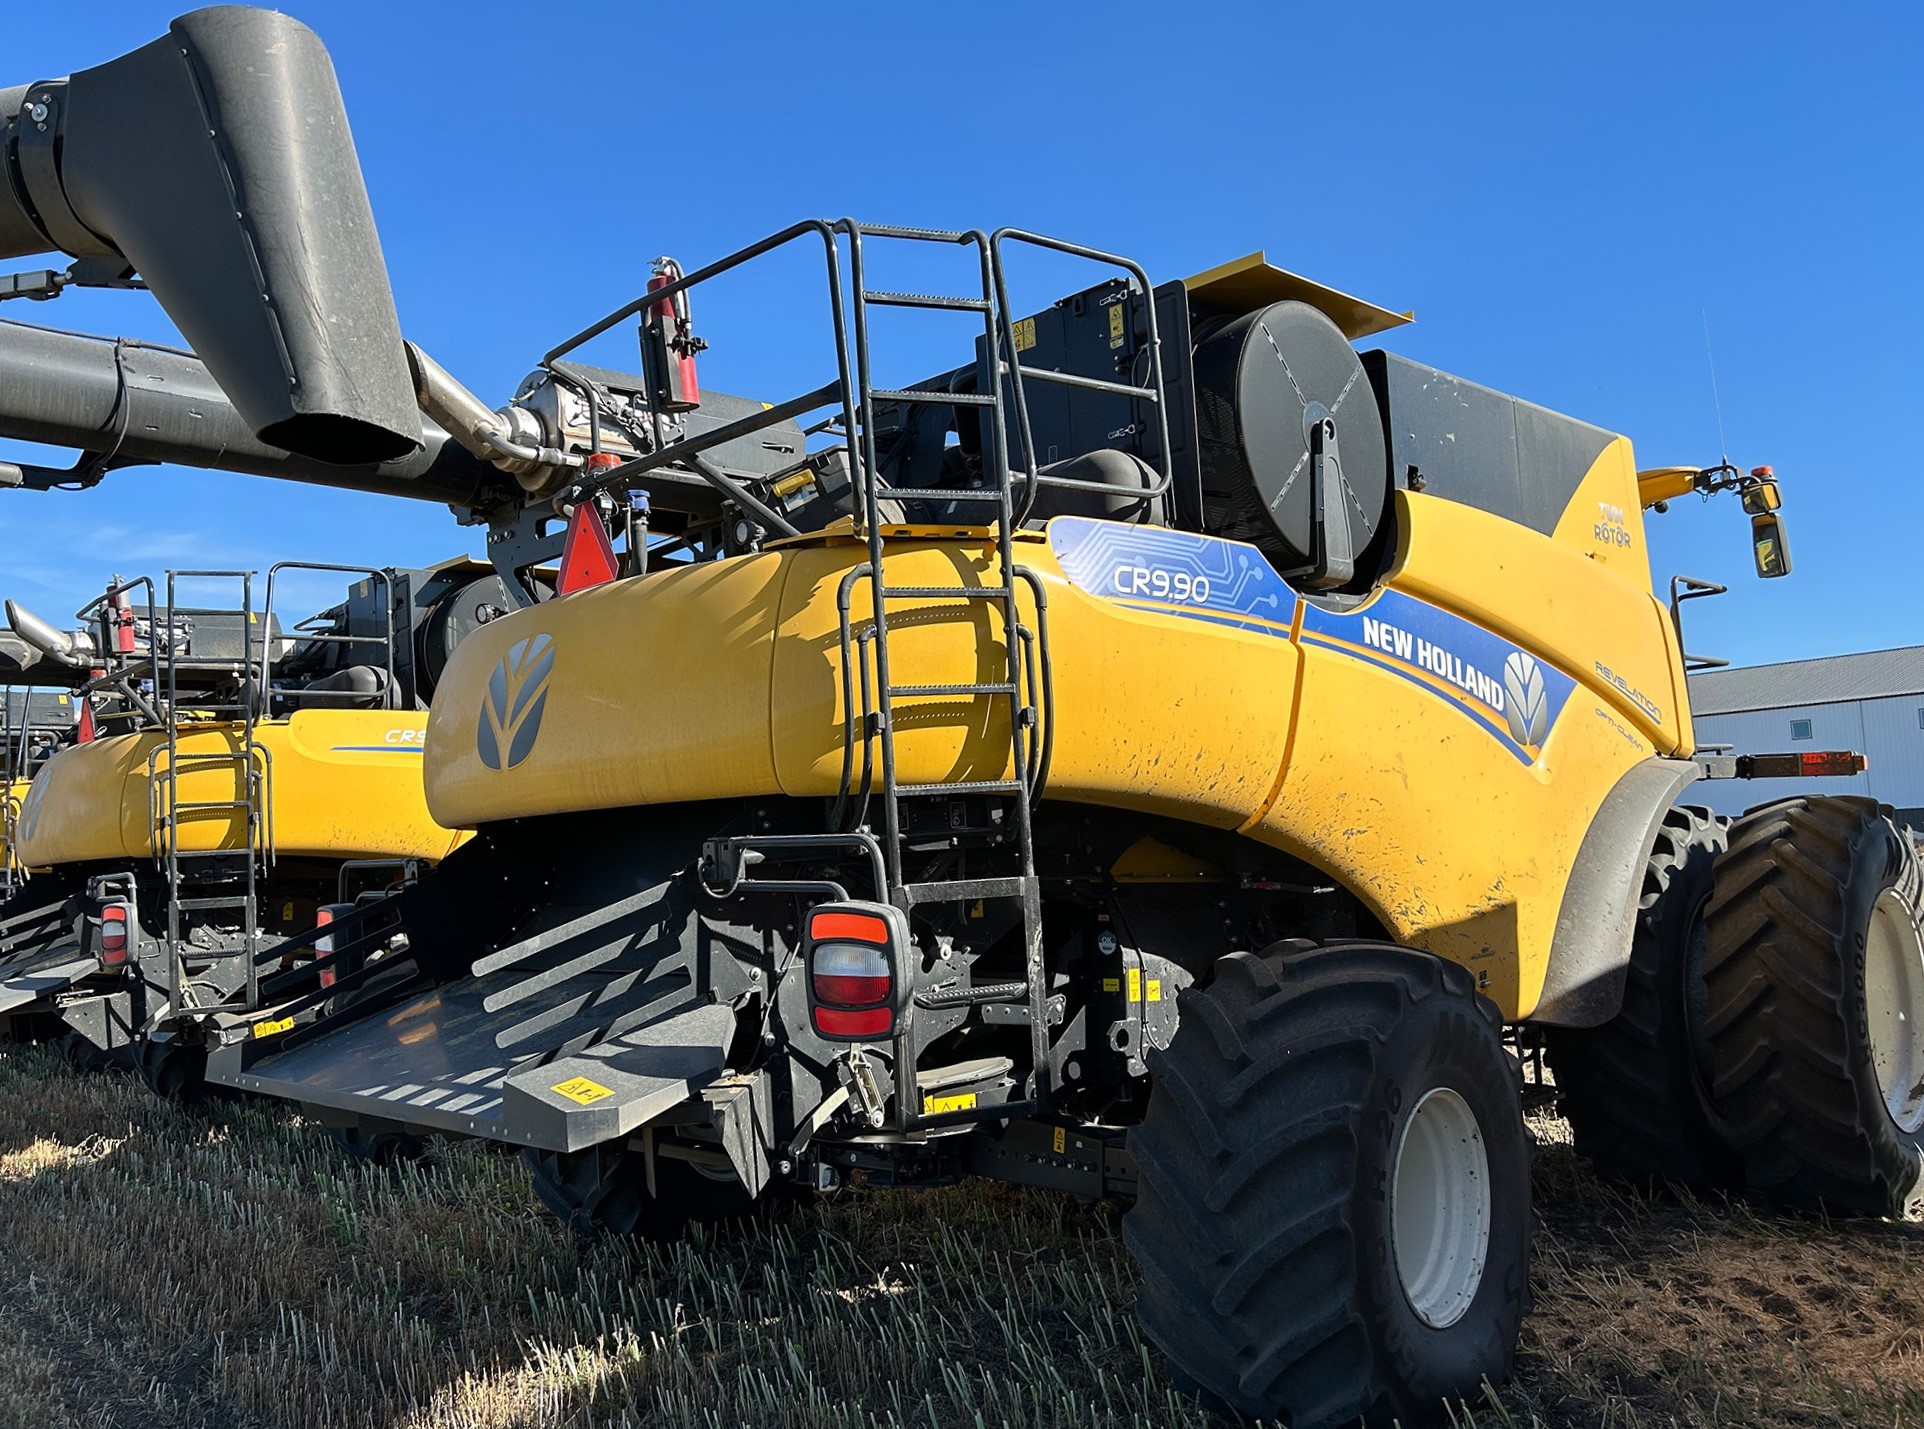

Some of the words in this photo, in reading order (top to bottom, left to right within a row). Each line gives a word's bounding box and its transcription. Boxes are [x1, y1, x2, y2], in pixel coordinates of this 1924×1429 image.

[1593, 521, 1632, 549] ROTOR
[1113, 564, 1210, 603] CR9.90
[1362, 615, 1413, 661] NEW
[1416, 637, 1505, 713] HOLLAND
[1595, 660, 1662, 721] REVELATION
